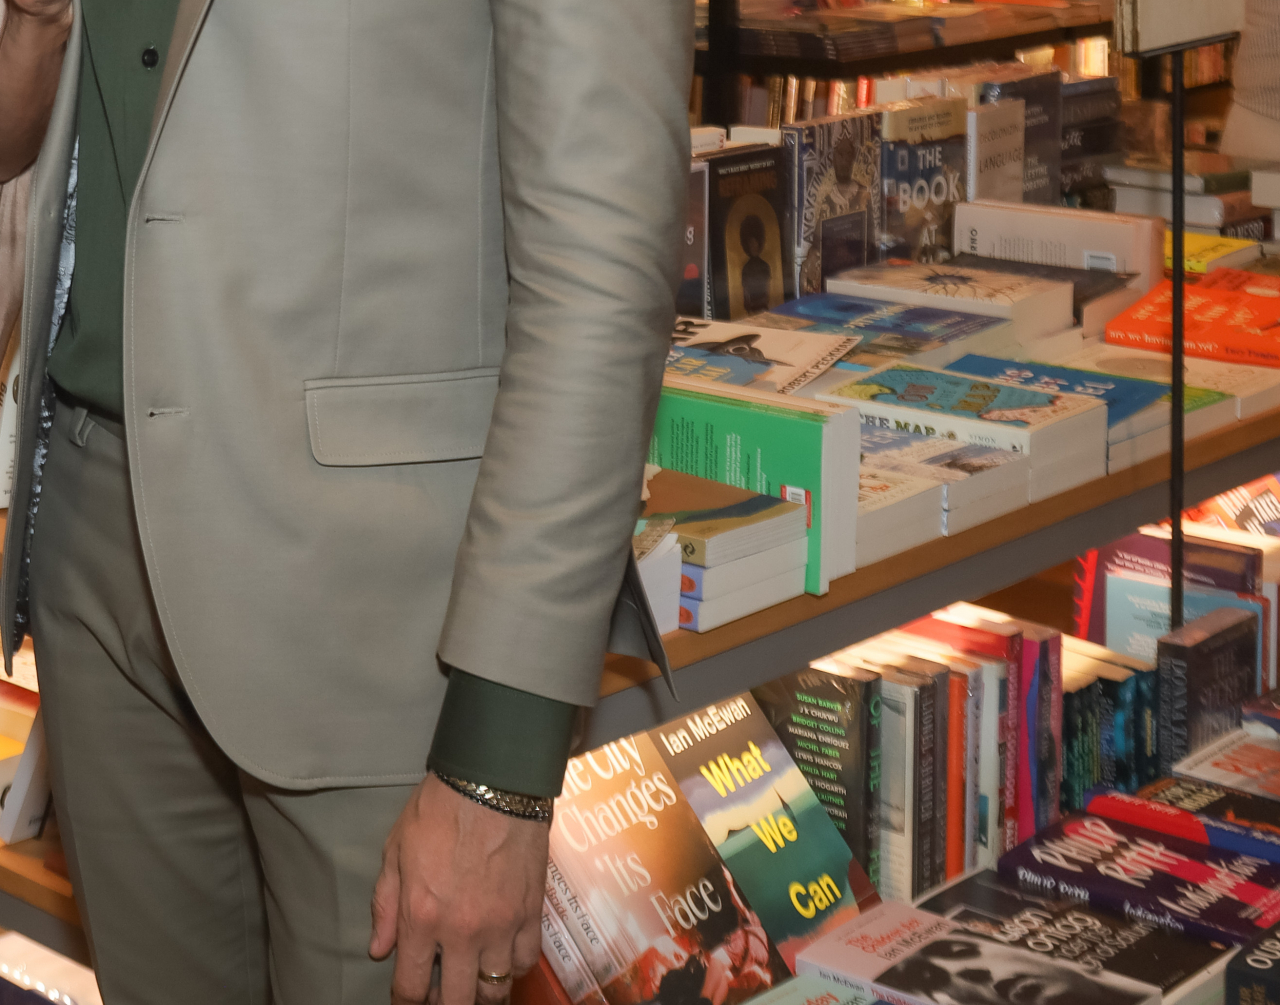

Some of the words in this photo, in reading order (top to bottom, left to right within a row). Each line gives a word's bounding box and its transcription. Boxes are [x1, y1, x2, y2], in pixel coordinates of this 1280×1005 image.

[918, 146, 942, 170] THE
[979, 148, 1022, 174] LANGUAGE
[898, 173, 960, 214] BOOK
[922, 225, 938, 247] AT
[1110, 329, 1126, 340] are
[1128, 332, 1141, 342] we
[1144, 333, 1172, 346] havin
[1198, 341, 1219, 353] yet?
[777, 368, 814, 395] ROBERT
[814, 337, 858, 372] PECKHAM
[894, 420, 936, 437] MAP
[796, 693, 817, 705] SUSAN
[818, 698, 842, 713] BARKER
[1007, 663, 1017, 728] HUSBAND
[1172, 659, 1187, 721] DONNA
[660, 728, 694, 757] Ian
[686, 697, 752, 743] McEwan
[792, 715, 818, 729] BRIDGET
[820, 722, 846, 737] COLLINS
[811, 709, 839, 723] CHUKWU
[870, 696, 882, 729] OF
[788, 726, 818, 741] MARIANA
[797, 740, 820, 753] MICHEL
[822, 747, 840, 759] FABER
[586, 733, 646, 781] City
[700, 740, 772, 798] What
[796, 751, 814, 763] LEWIS
[815, 757, 843, 771] HANCOX
[799, 763, 820, 776] EMILIA
[822, 769, 838, 781] HART
[870, 749, 882, 793] THE
[1005, 731, 1017, 807] COOKBOOK
[816, 779, 847, 796] HOGARTH
[558, 771, 677, 853] Changes
[750, 814, 798, 854] We
[650, 877, 722, 939] Face
[788, 873, 842, 919] Can
[568, 895, 580, 914] Its
[578, 913, 600, 947] Face
[550, 931, 572, 965] Face
[877, 947, 902, 961] Ian
[900, 921, 950, 952] McEwan
[820, 969, 832, 980] Ian
[832, 975, 866, 994] McEwan
